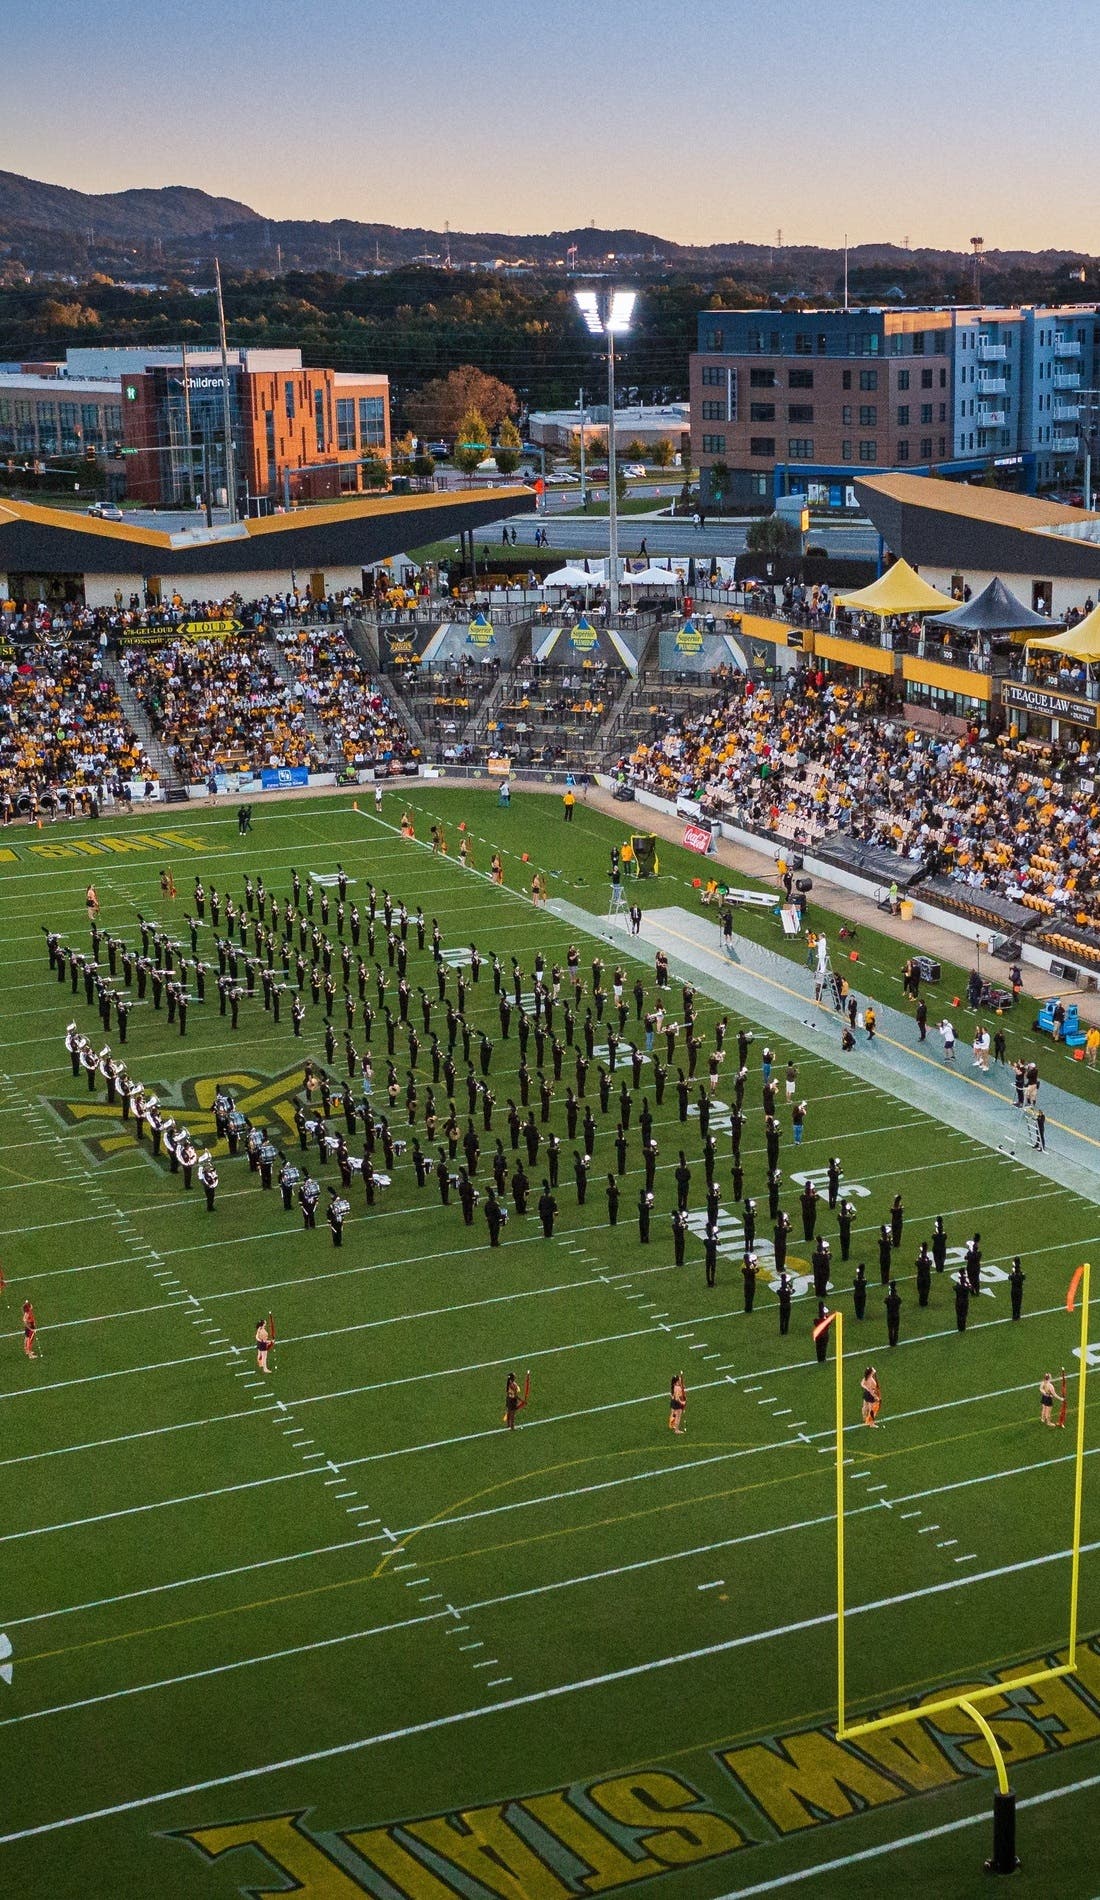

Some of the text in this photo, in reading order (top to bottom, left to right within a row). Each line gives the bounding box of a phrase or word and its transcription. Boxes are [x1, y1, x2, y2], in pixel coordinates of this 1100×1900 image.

[193, 622, 226, 631] LOUD
[1010, 686, 1071, 712] TEAGUE LAW
[29, 831, 232, 859] STATE
